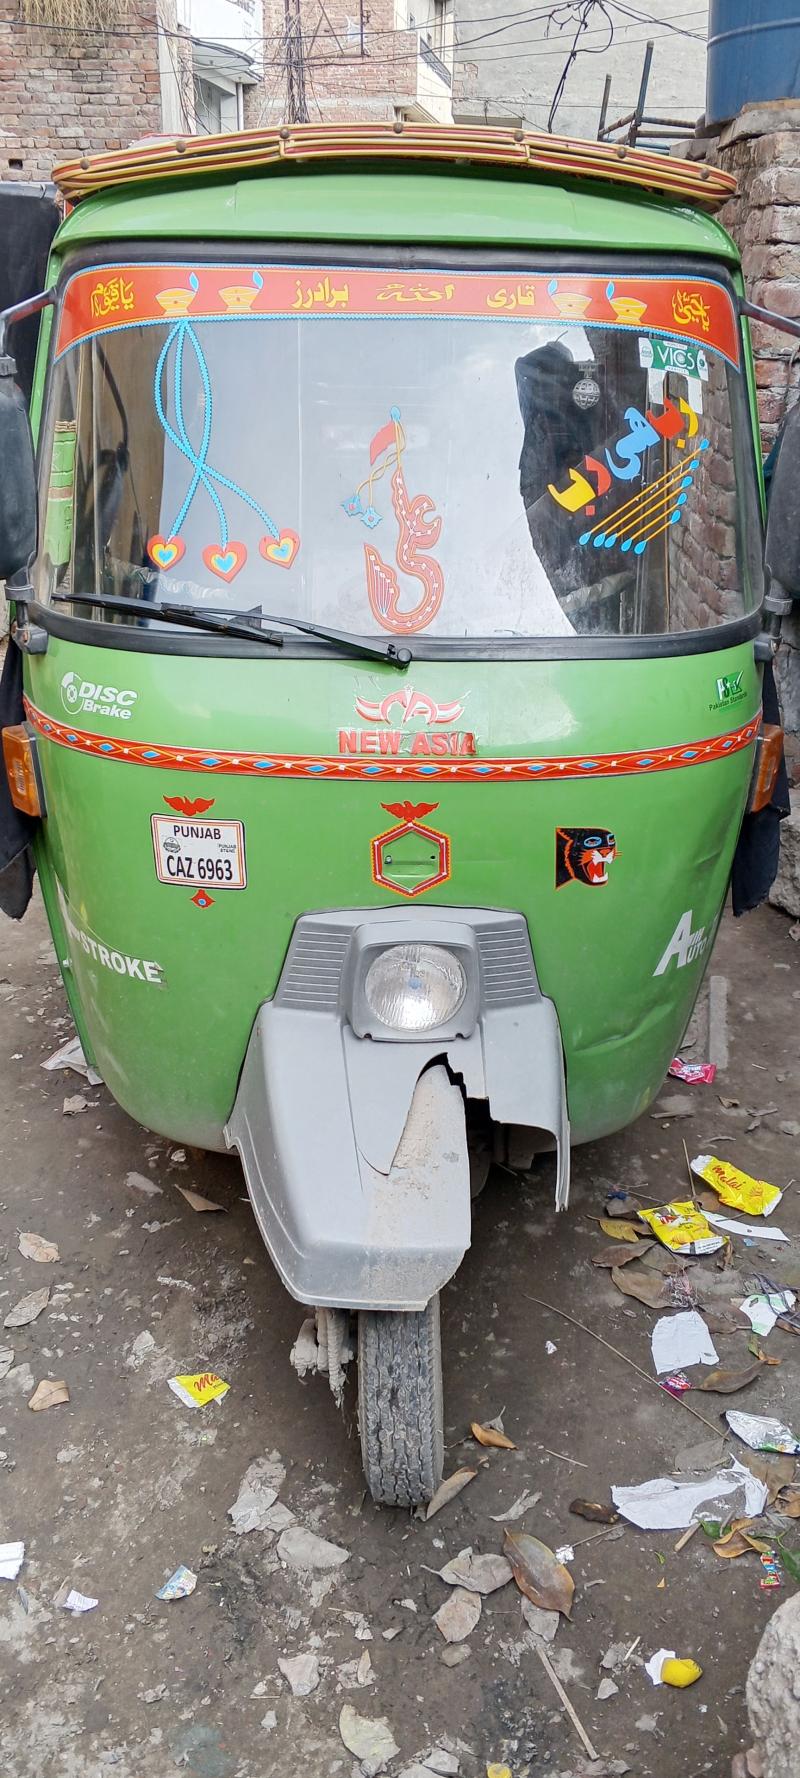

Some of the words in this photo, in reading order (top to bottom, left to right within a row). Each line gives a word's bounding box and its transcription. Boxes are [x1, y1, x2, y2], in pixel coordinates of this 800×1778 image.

[290, 276, 350, 309] برادرز
[656, 345, 696, 371] VICS
[79, 681, 138, 706] DISC
[82, 699, 132, 720] Brake
[338, 728, 400, 755] NEW
[410, 731, 477, 756] ASIA
[173, 824, 221, 840] PUNJAB
[166, 855, 195, 878] CAZ
[197, 858, 233, 881] 6963
